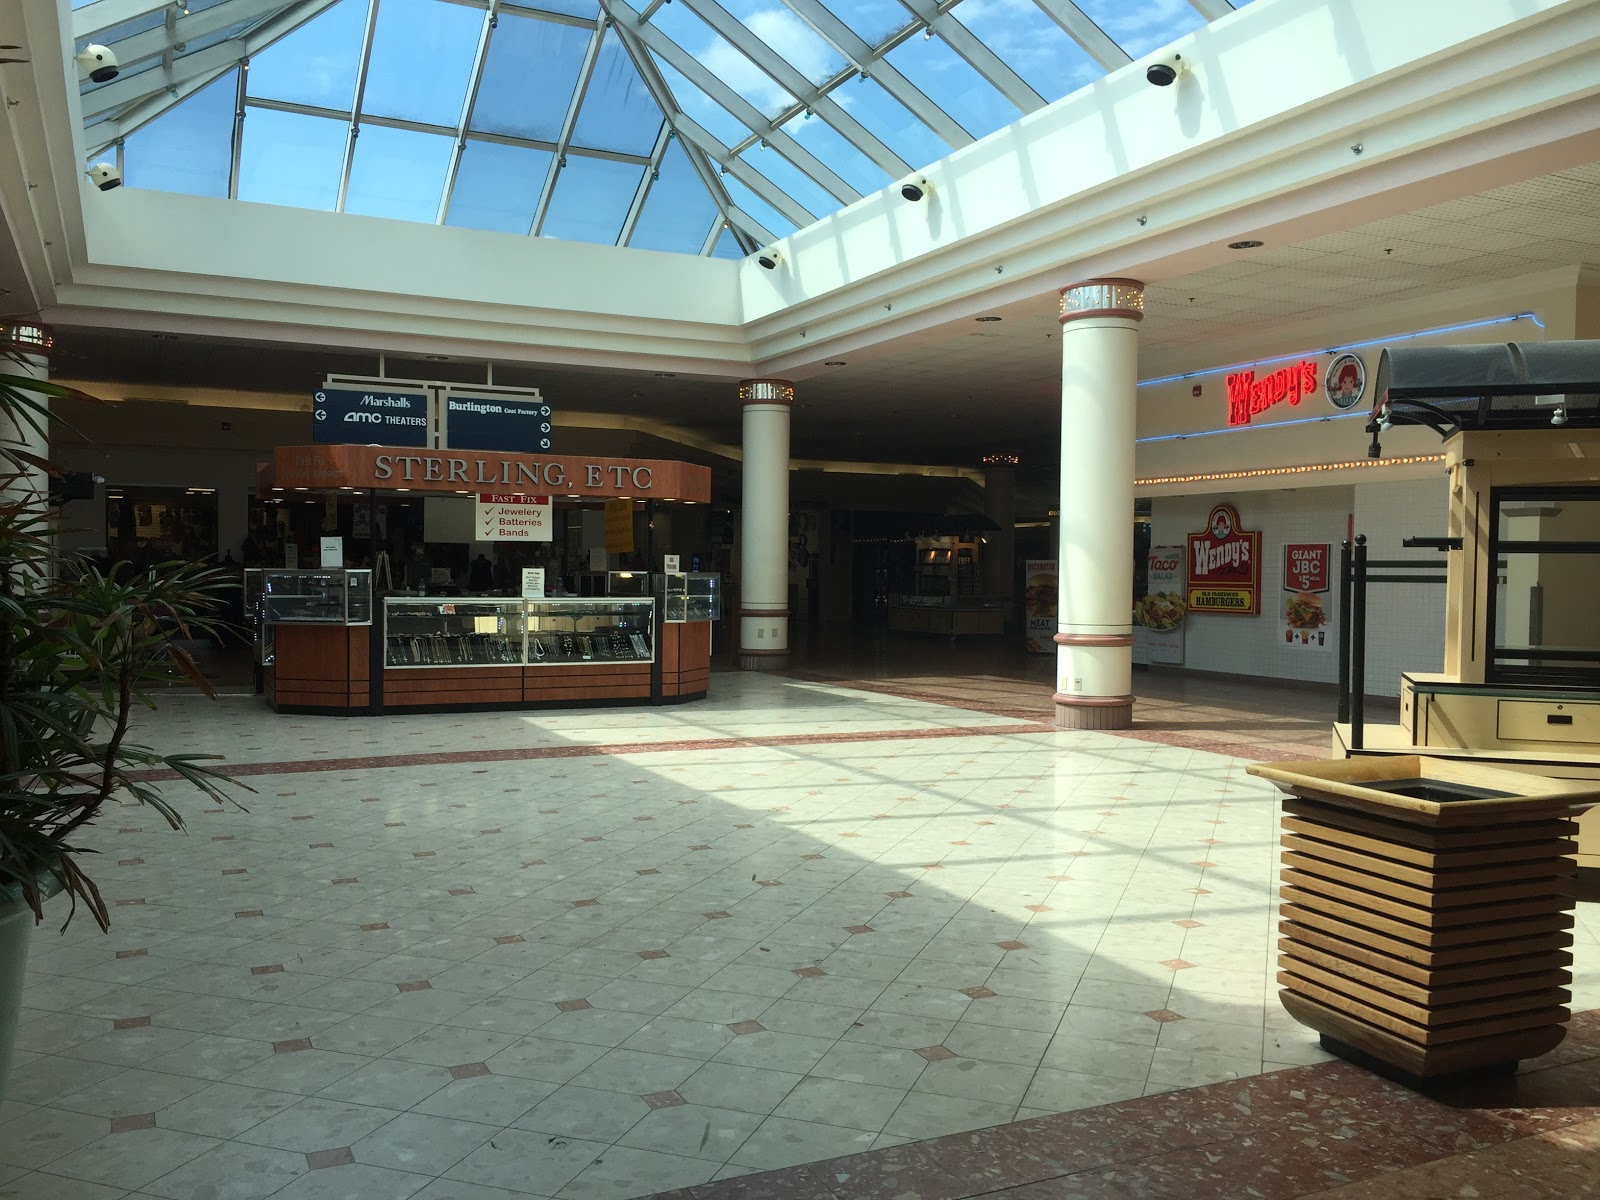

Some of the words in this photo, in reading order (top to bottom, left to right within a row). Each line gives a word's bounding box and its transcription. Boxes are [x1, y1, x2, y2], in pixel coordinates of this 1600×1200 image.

[360, 395, 411, 409] Marshalls
[449, 401, 502, 414] Burlington
[518, 408, 538, 416] Factory
[385, 415, 427, 427] THEATERS
[374, 455, 573, 489] STERLING,
[585, 464, 653, 489] ETC
[491, 494, 516, 503] FAST
[520, 495, 537, 504] FIX
[498, 507, 542, 518] Jewelery
[499, 518, 543, 527] Batteries
[499, 528, 529, 537] Bands
[1291, 550, 1322, 560] GIANT
[1149, 555, 1179, 571] Taco
[1292, 560, 1320, 574] JBC
[1196, 597, 1245, 608] HAMBURGERS
[1030, 619, 1050, 627] MEAT
